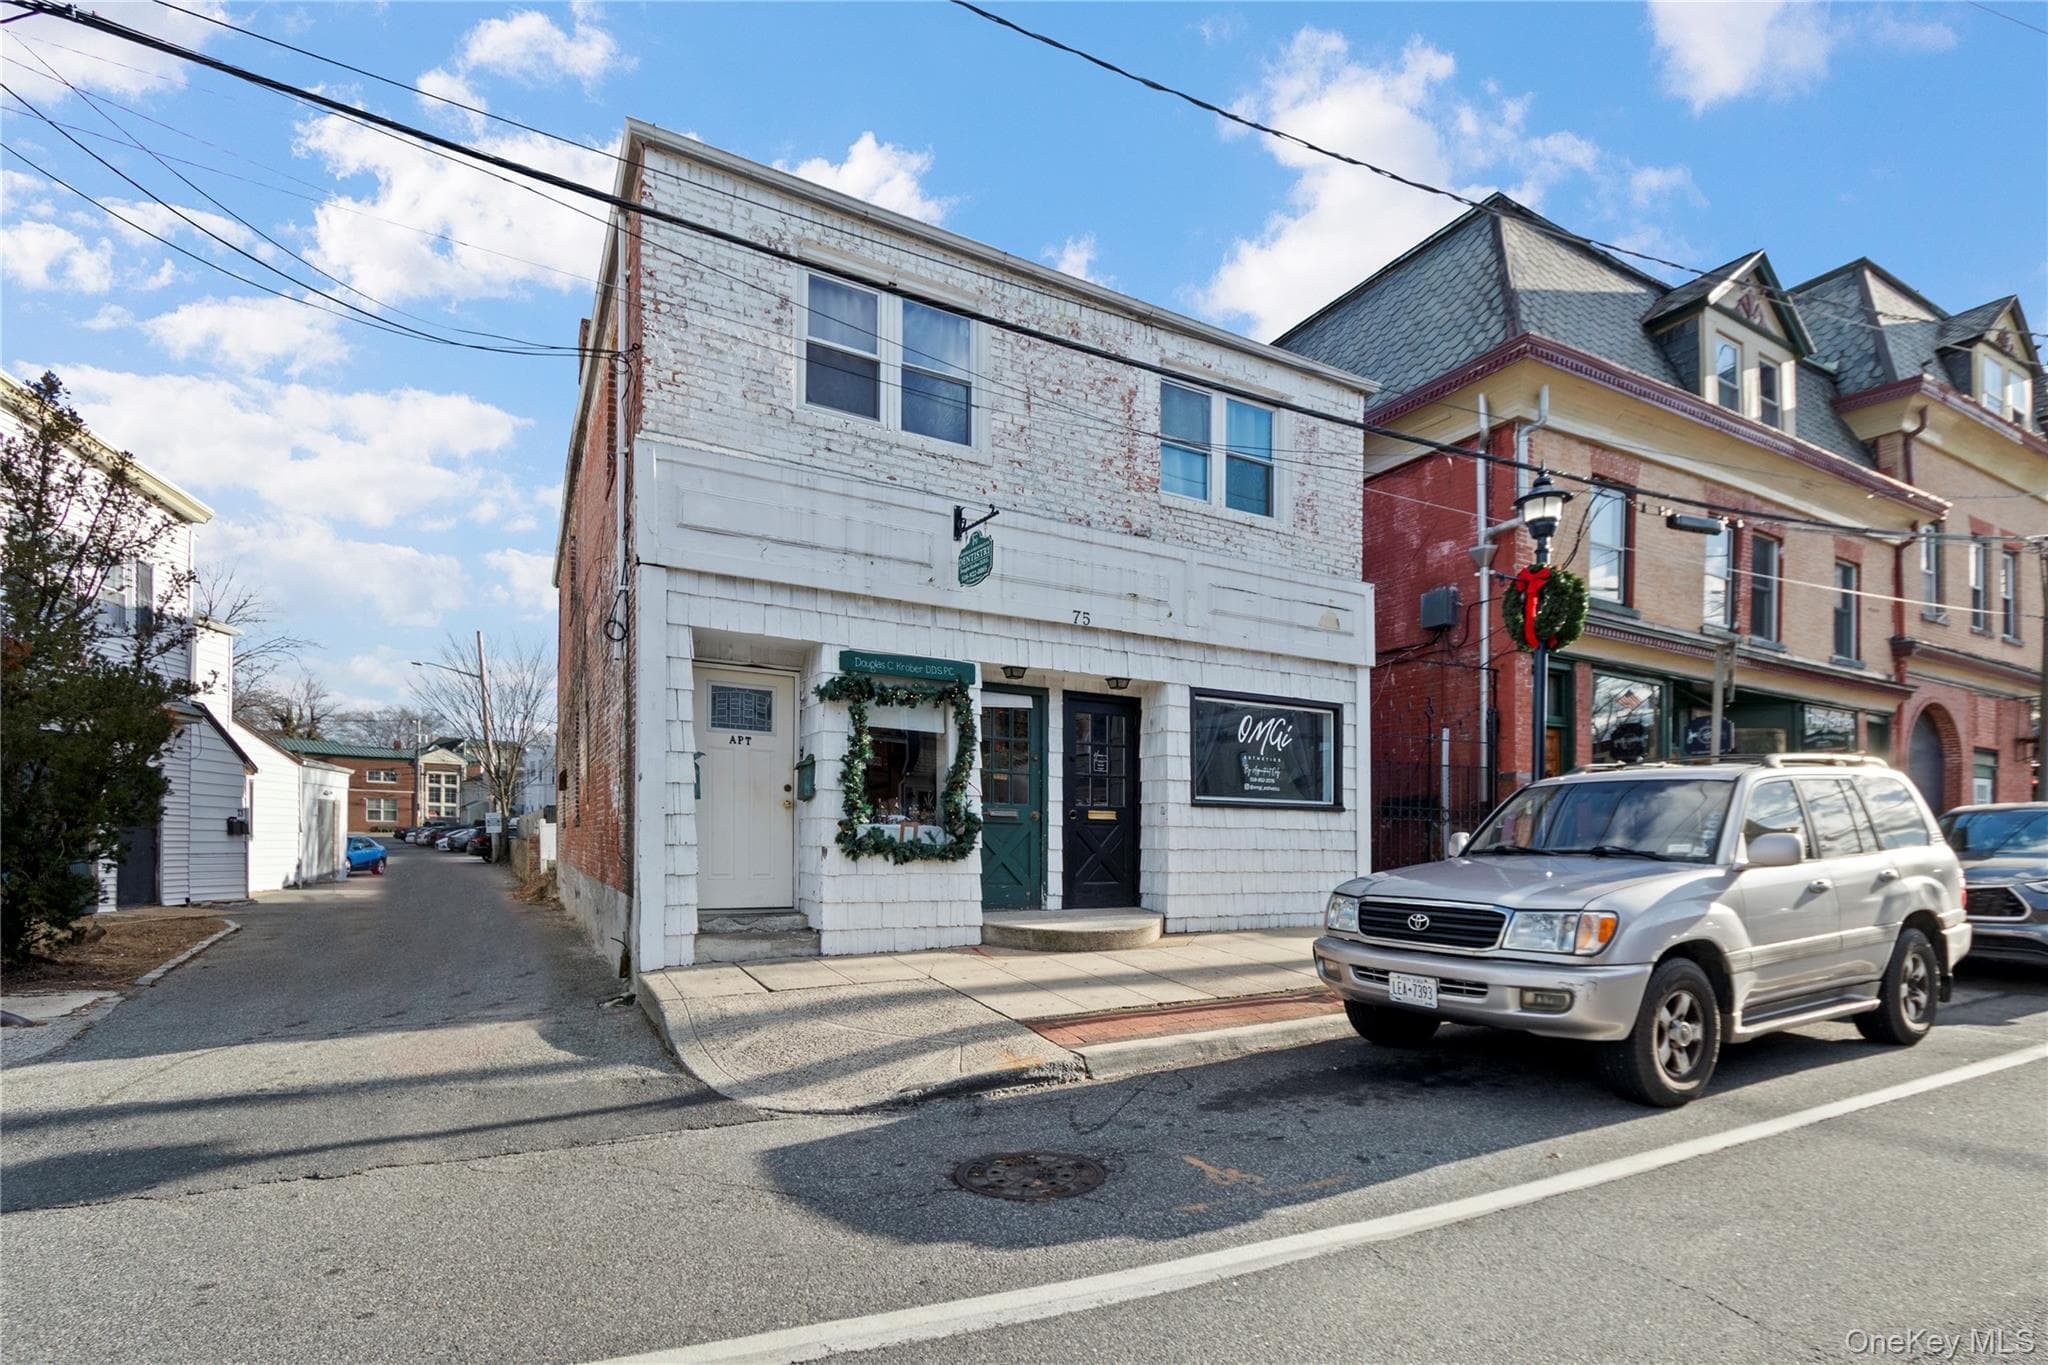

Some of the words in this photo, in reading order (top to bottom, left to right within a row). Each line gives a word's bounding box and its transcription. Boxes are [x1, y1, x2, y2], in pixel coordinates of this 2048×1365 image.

[959, 545, 990, 567] DENTISTRY
[1072, 609, 1090, 625] 75
[854, 656, 886, 672] Douglas
[887, 660, 894, 670] C
[729, 735, 752, 746] APT
